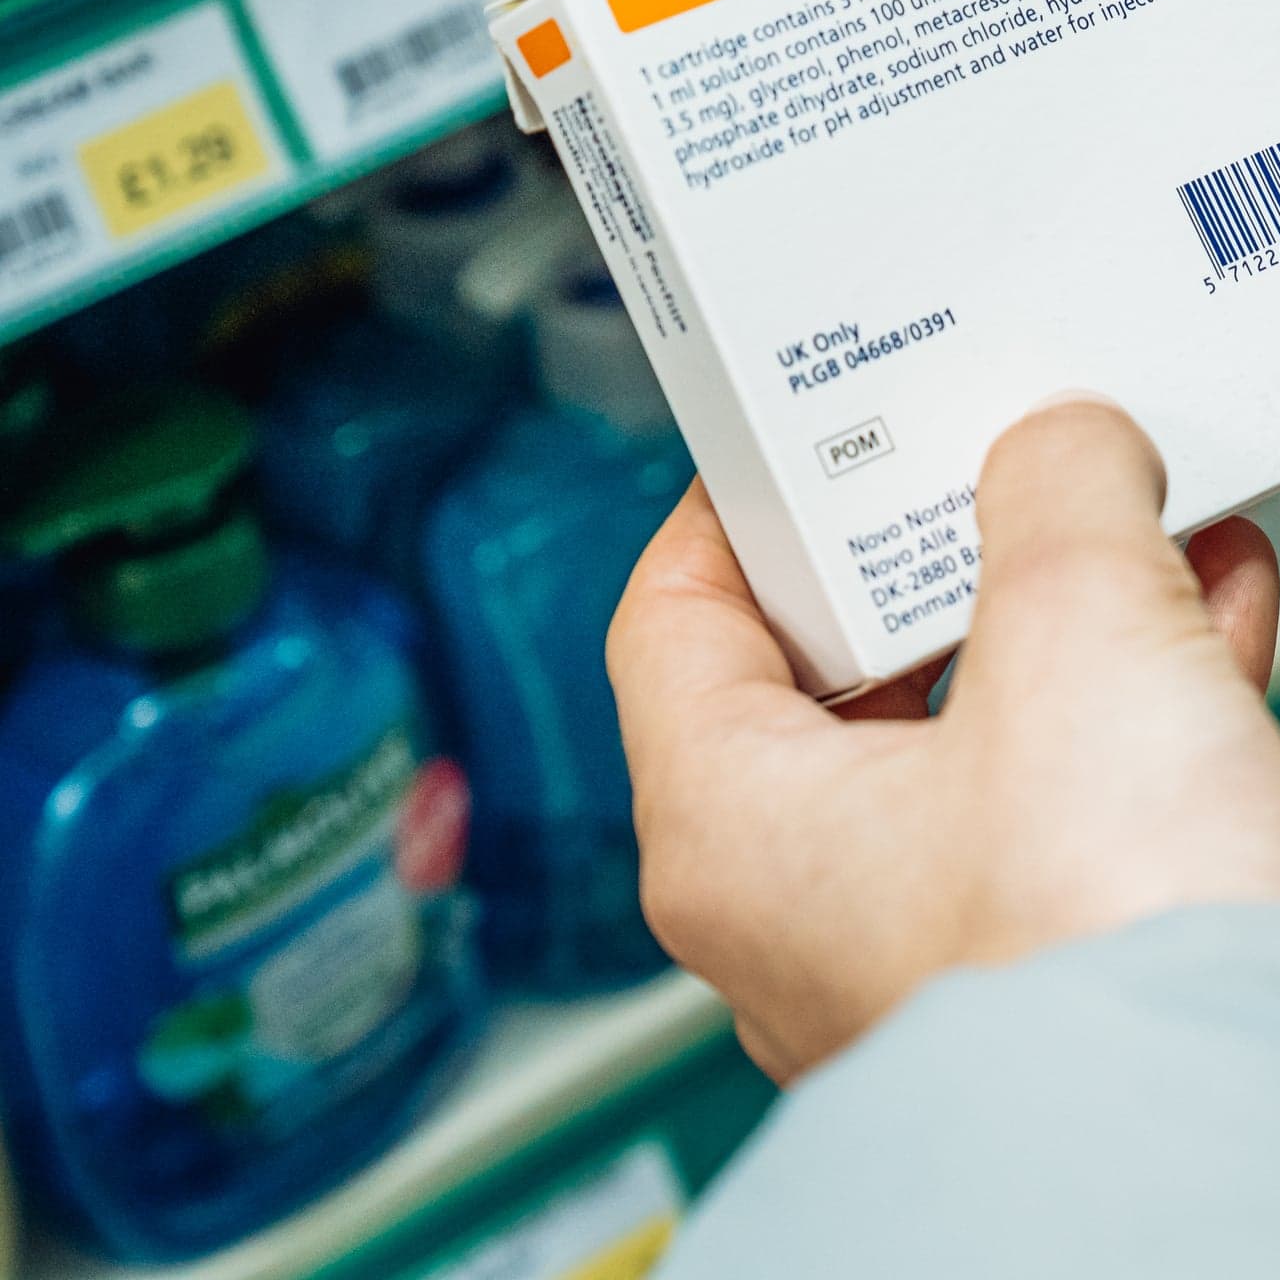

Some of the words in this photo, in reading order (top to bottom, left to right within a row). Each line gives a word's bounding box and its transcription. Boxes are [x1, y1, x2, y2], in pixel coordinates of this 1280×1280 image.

[638, 65, 652, 85] 1
[656, 32, 749, 79] cartridge
[650, 91, 664, 110] 1
[668, 78, 696, 105] ml
[698, 50, 782, 94] solution
[783, 15, 868, 60] contains
[661, 109, 694, 139] 3.5
[747, 55, 833, 109] glycerol,
[834, 24, 911, 75] phenol,
[673, 110, 780, 169] phosphate
[782, 70, 885, 120] dihydrate,
[885, 38, 959, 80] sodium
[960, 4, 1044, 49] chloride,
[681, 136, 785, 189] hydroxide
[786, 122, 818, 147] for
[822, 105, 854, 139] pH
[856, 61, 967, 121] adjustment
[967, 41, 1007, 76] and
[1006, 23, 1064, 58] water
[1065, 9, 1096, 35] for
[1204, 277, 1216, 295] 5
[777, 342, 810, 369] UK
[812, 321, 861, 352] Only
[788, 358, 841, 394] PLGB
[844, 307, 957, 370] 04668/0391
[829, 429, 880, 464] POM
[847, 523, 902, 558] Novo
[859, 548, 913, 582] Novo
[871, 554, 958, 608] DK-2880
[883, 578, 978, 634] Denmark
